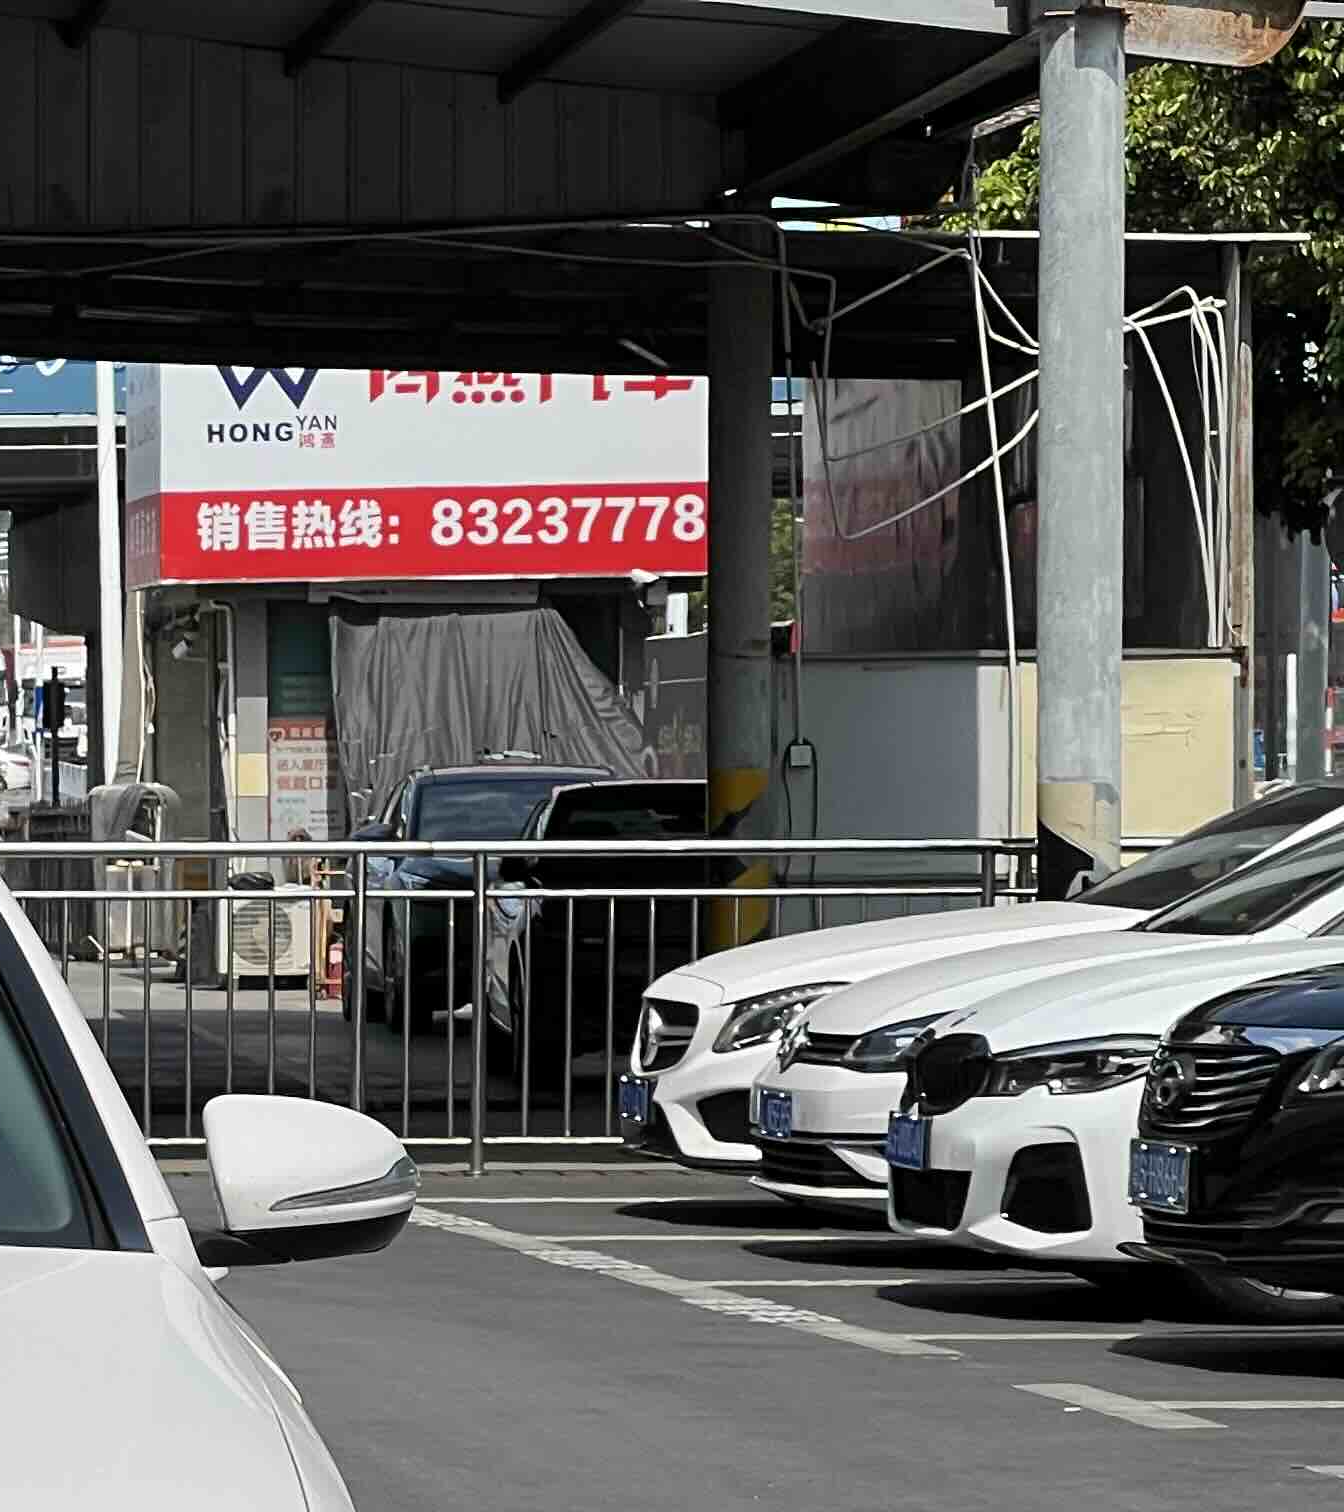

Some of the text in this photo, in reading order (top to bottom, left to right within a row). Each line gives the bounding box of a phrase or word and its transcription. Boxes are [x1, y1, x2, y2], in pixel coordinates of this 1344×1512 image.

[207, 415, 337, 443] HONG YAN
[430, 494, 706, 546] 83237778
